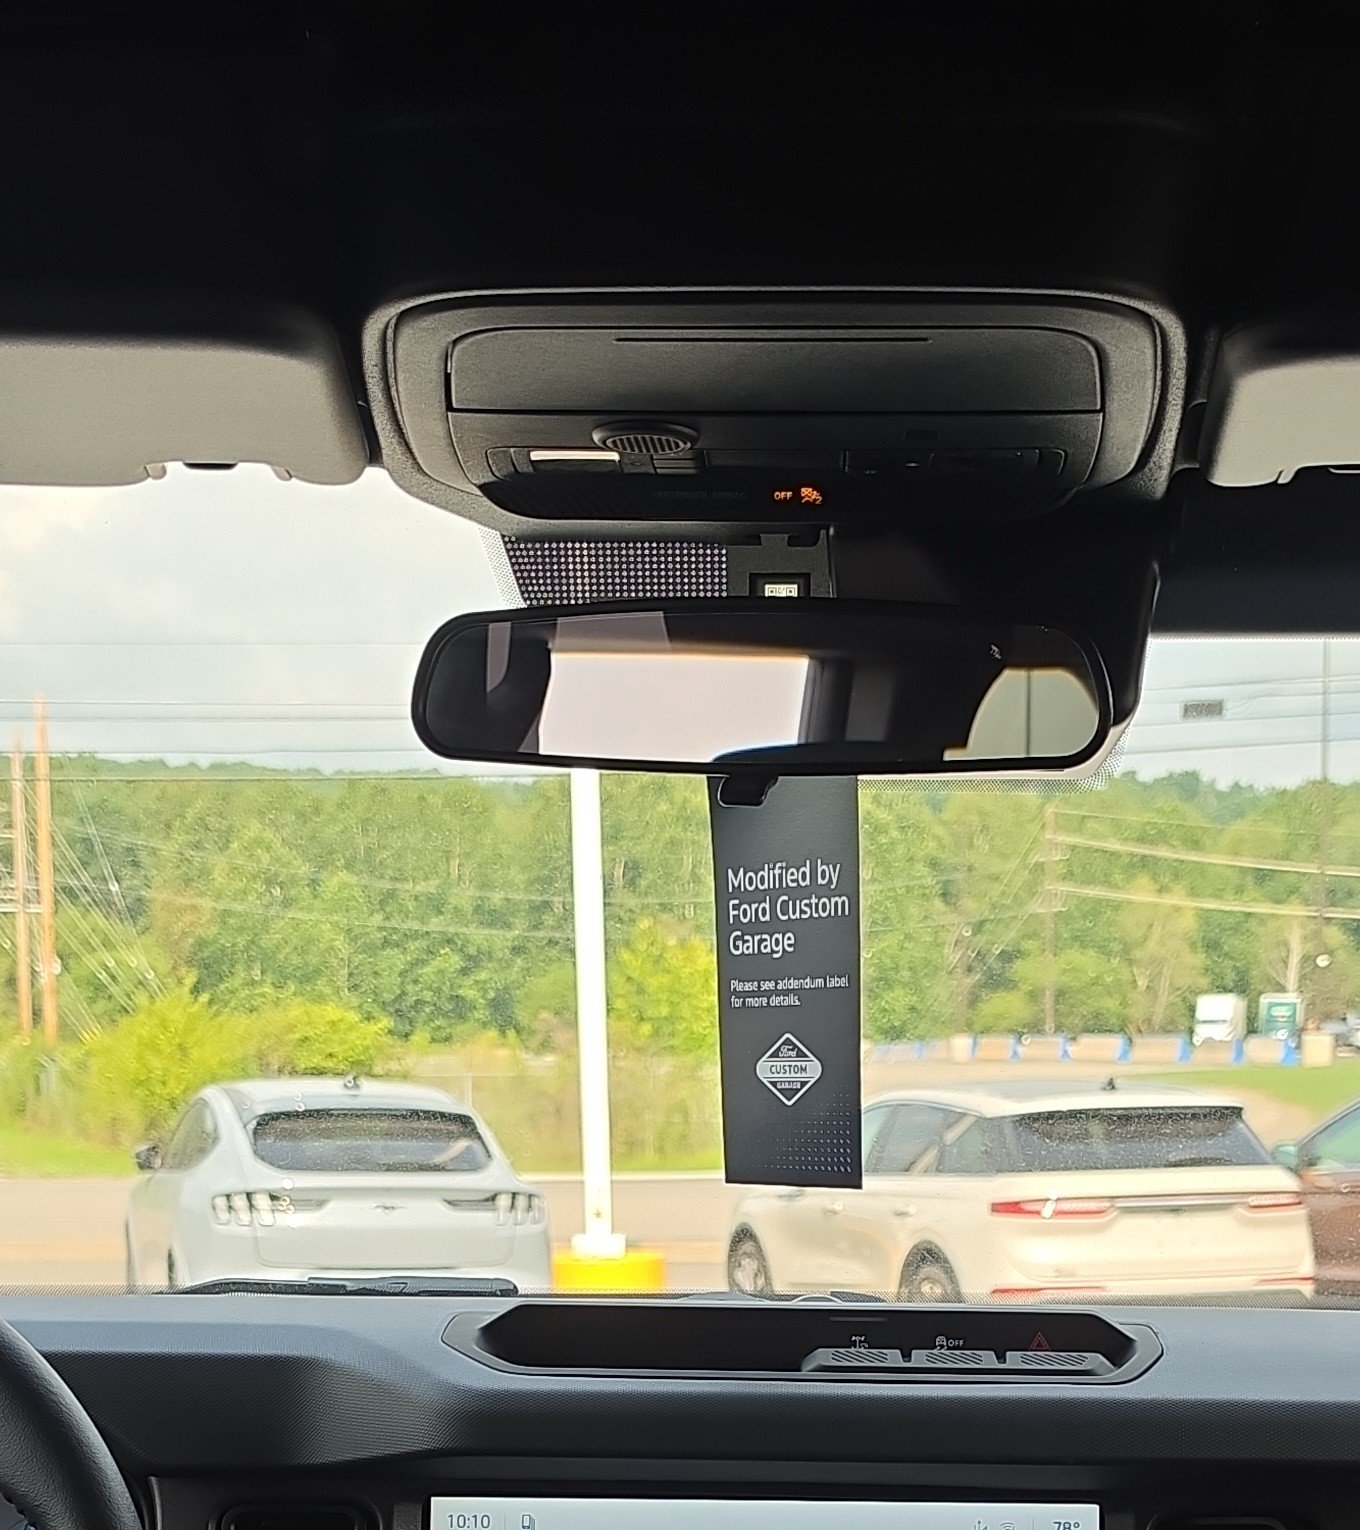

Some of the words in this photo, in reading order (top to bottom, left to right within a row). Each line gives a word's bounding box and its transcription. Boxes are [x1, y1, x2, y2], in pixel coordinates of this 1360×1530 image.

[774, 492, 793, 501] OFF
[727, 859, 813, 894] Modified
[817, 859, 842, 890] by
[729, 896, 770, 924] Ford
[776, 892, 850, 921] Custom
[729, 930, 795, 958] Garage
[730, 978, 758, 992] Please
[760, 978, 776, 991] see
[777, 975, 824, 991] addendum
[826, 973, 849, 989] label
[730, 994, 744, 1007] for
[745, 996, 768, 1007] more
[769, 993, 801, 1007] details.
[769, 1064, 808, 1075] CUSTOM
[948, 1339, 964, 1348] OFF
[446, 1513, 491, 1530] 10:10
